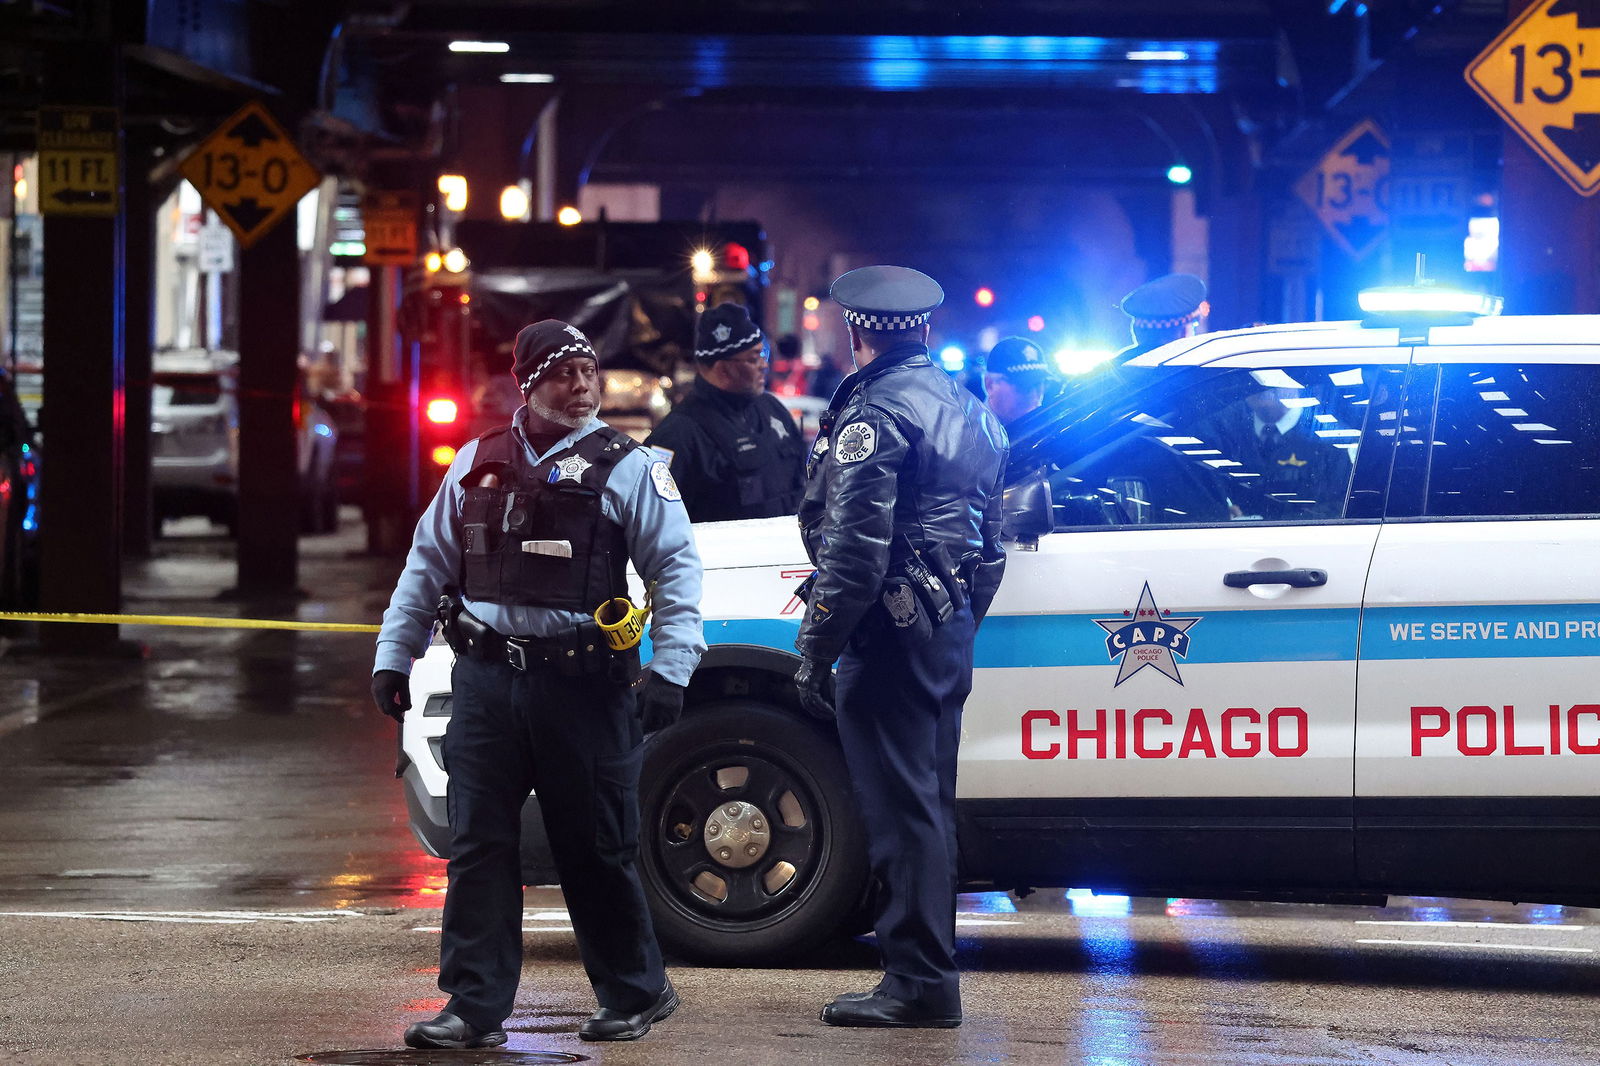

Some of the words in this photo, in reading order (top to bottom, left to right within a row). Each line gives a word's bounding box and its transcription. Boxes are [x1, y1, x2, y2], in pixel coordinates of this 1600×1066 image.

[48, 159, 70, 182] 11
[840, 424, 871, 445] CHICAGO
[839, 446, 869, 461] POLICE
[1112, 627, 1184, 649] CAPS
[1389, 623, 1425, 641] WE
[1430, 622, 1508, 640] SERVE
[1514, 621, 1560, 639] AND
[1565, 620, 1600, 639] PR
[1020, 706, 1309, 760] CHICAGO
